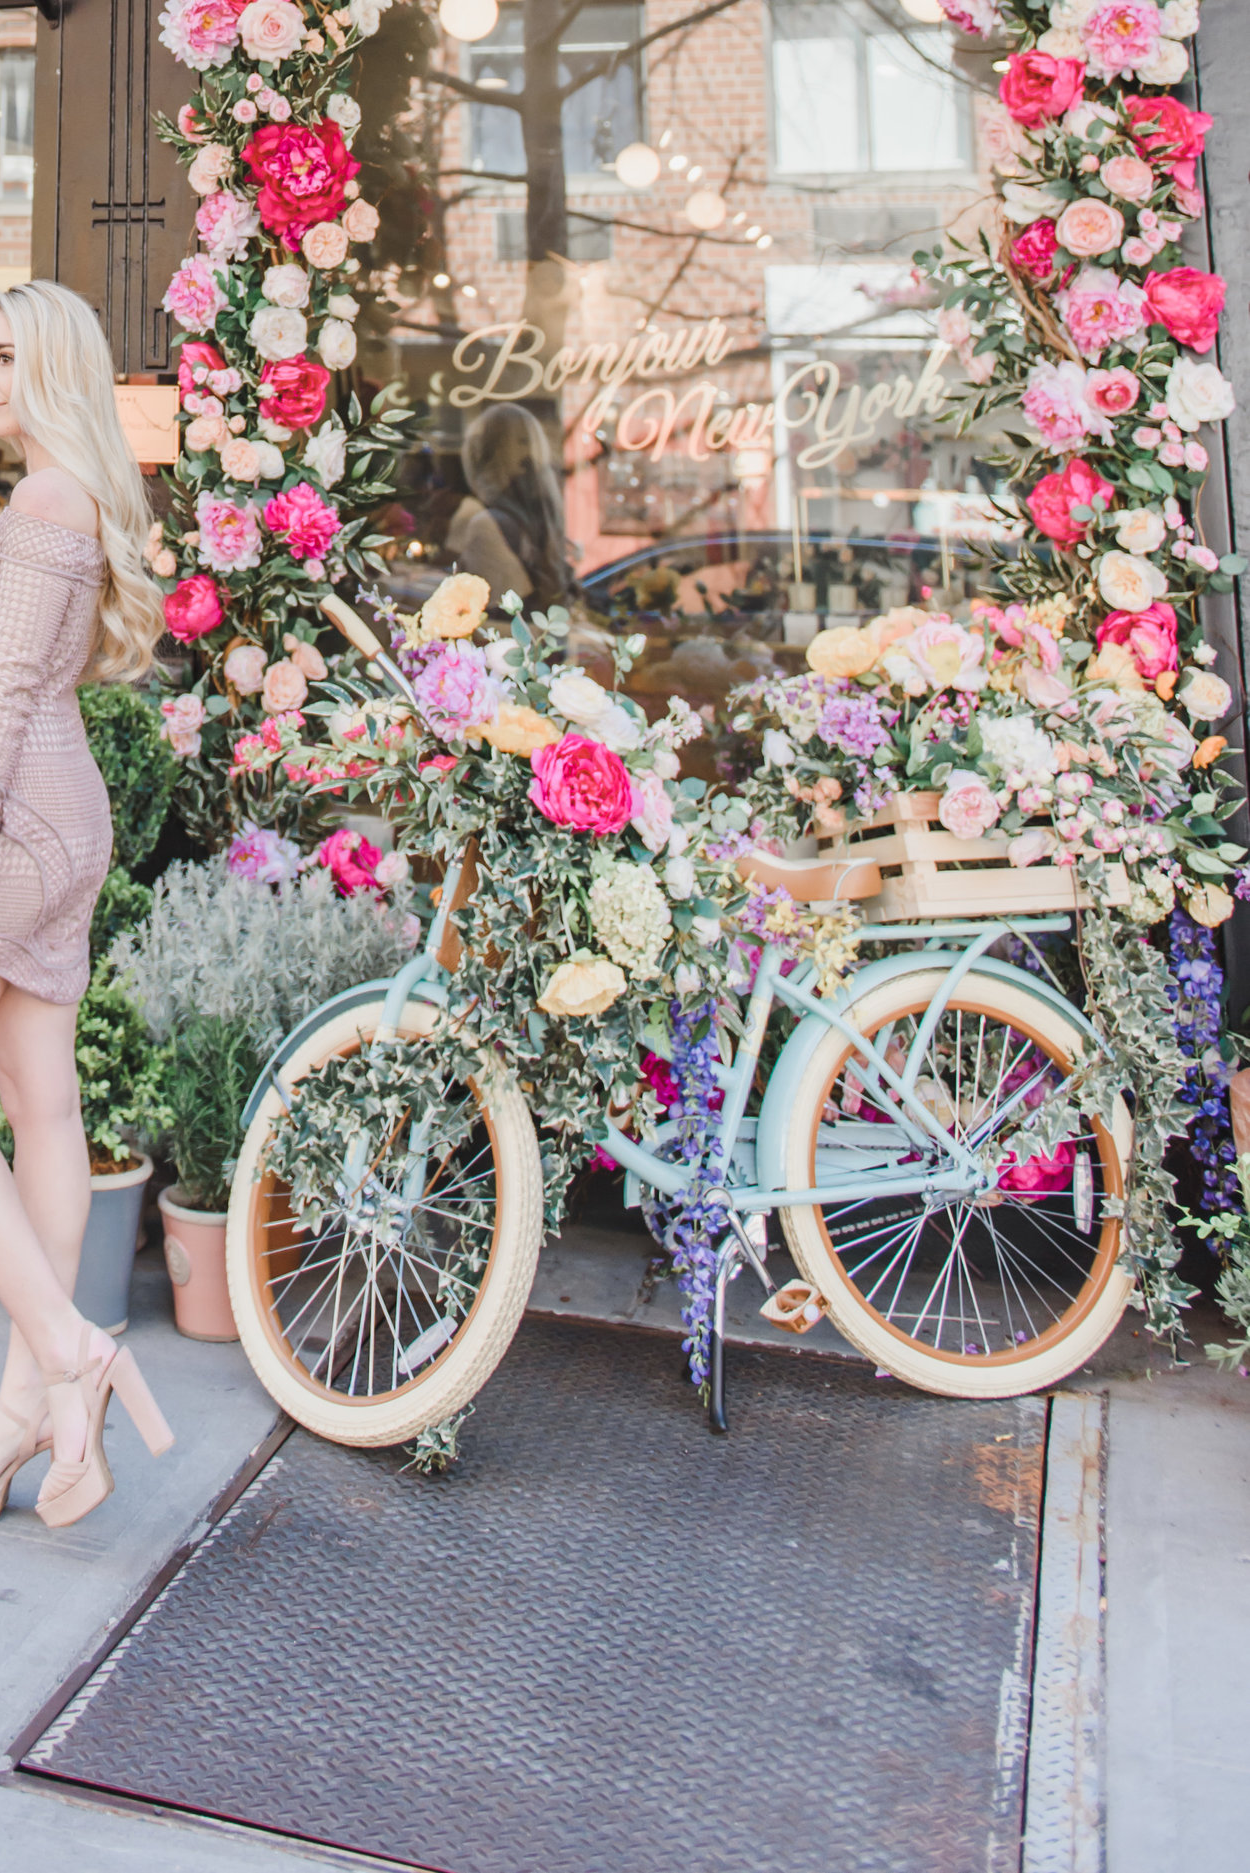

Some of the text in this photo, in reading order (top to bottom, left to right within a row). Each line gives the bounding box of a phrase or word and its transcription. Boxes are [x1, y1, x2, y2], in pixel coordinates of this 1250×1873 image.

[449, 318, 734, 434] Bonjour
[616, 347, 956, 470] New York
